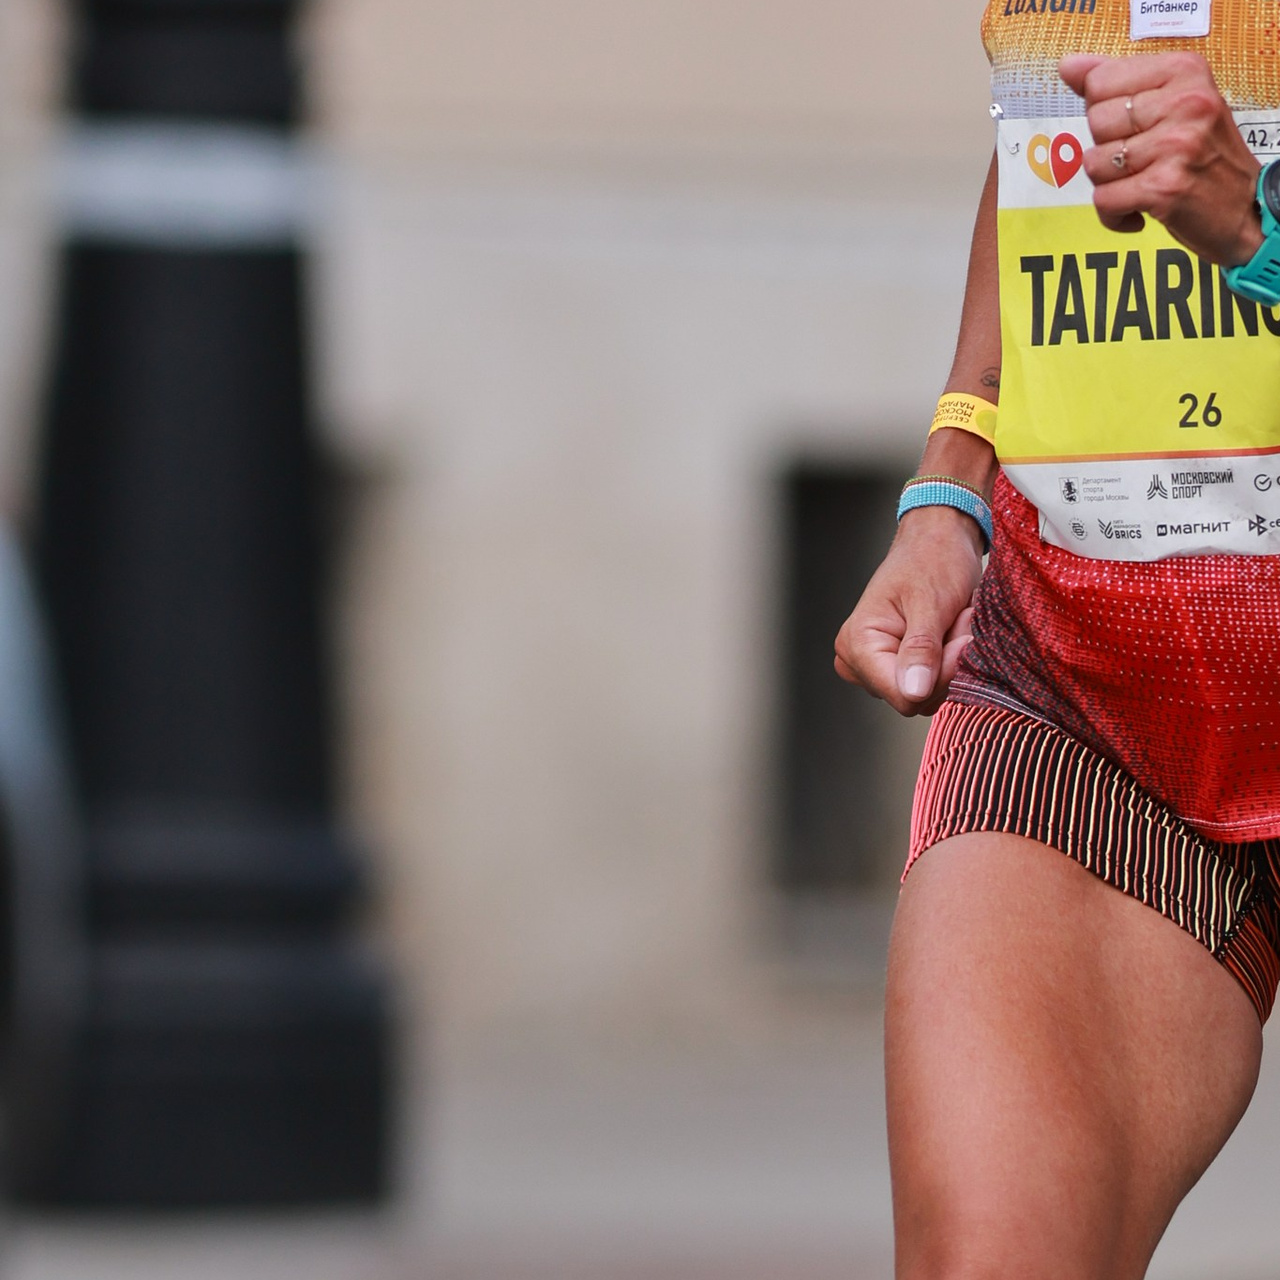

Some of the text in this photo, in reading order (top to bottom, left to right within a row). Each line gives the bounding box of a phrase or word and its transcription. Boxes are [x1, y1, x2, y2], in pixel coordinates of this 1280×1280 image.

[1140, 1, 1198, 15] Битбанкер
[1178, 392, 1223, 429] 26
[1171, 469, 1234, 486] МОСКОВСКИЙ
[1172, 485, 1203, 500] СПОРТ
[1114, 529, 1142, 539] BRICS
